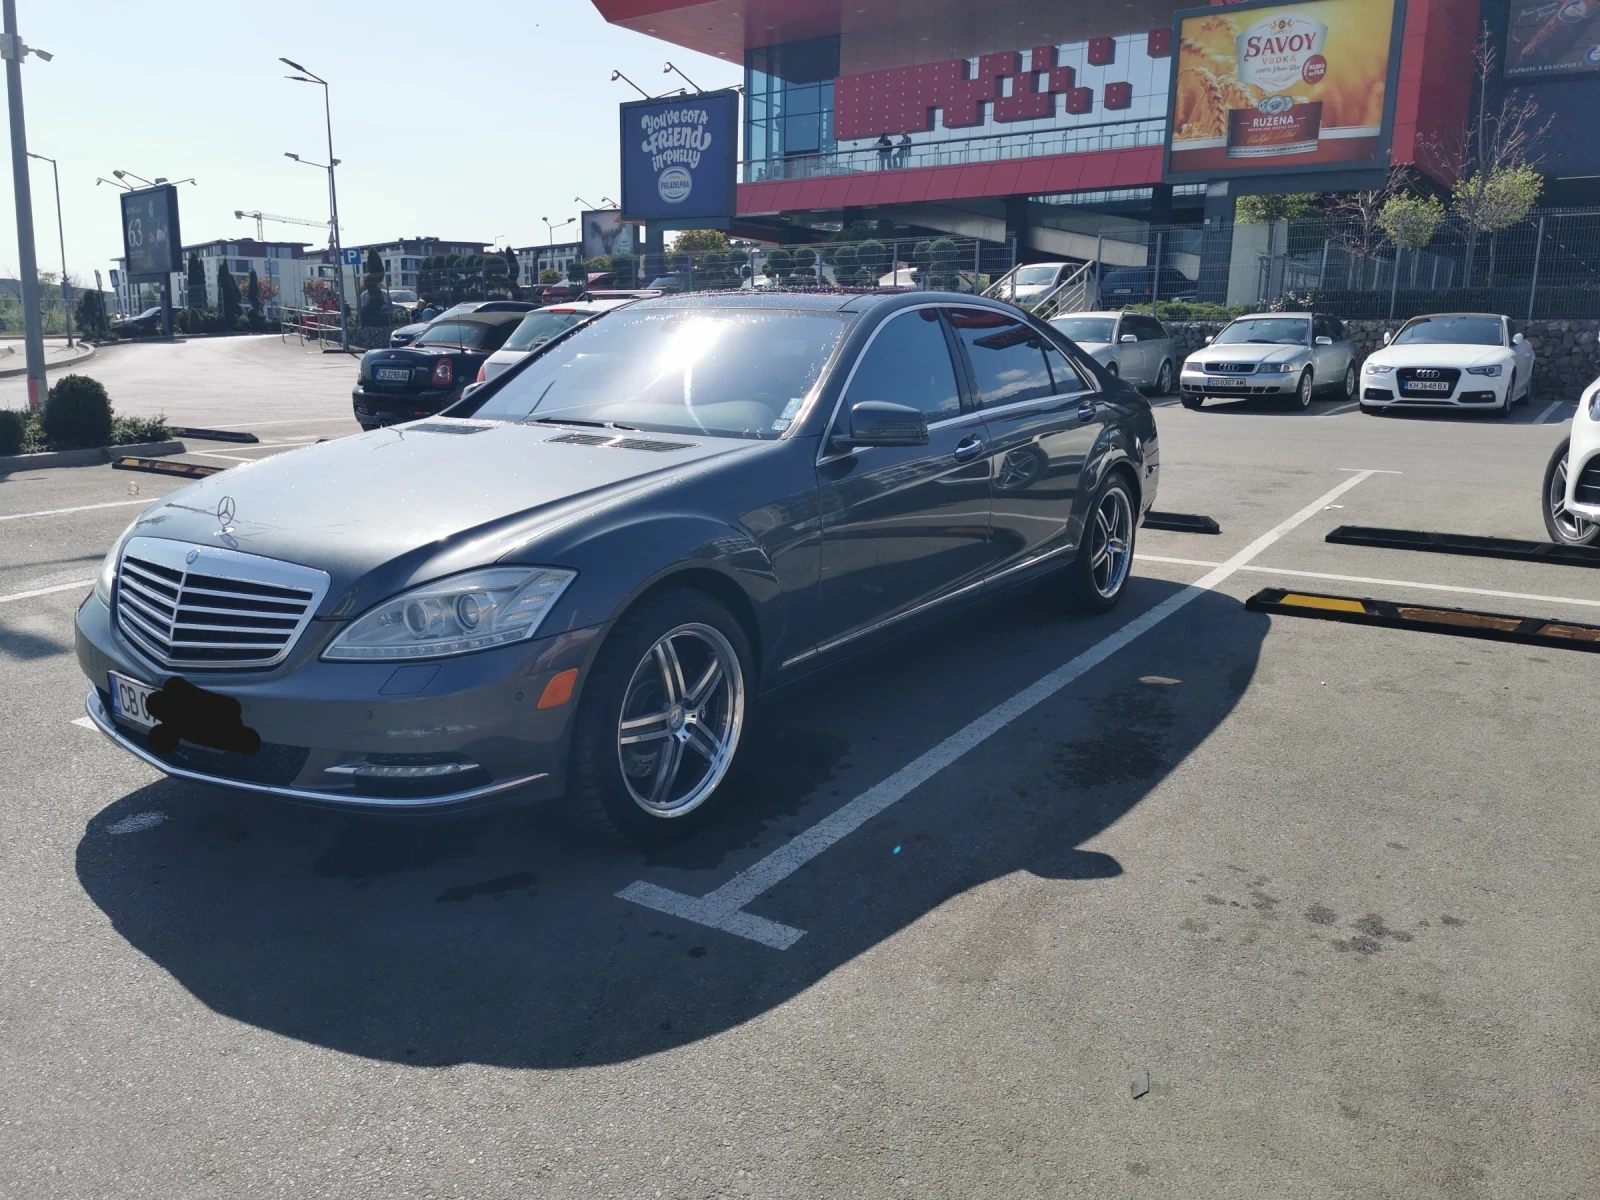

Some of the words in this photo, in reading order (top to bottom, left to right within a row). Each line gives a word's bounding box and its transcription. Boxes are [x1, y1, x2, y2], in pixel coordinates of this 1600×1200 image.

[1243, 32, 1317, 62] SAVOY
[1262, 55, 1297, 65] VODKA
[680, 109, 701, 124] GOT
[699, 110, 709, 125] A
[1252, 115, 1294, 128] RUŽENA
[660, 180, 690, 190] PHILADELPHIA
[128, 217, 144, 247] 63
[347, 250, 357, 263] P
[1437, 382, 1448, 390] BX
[119, 683, 139, 717] CB
